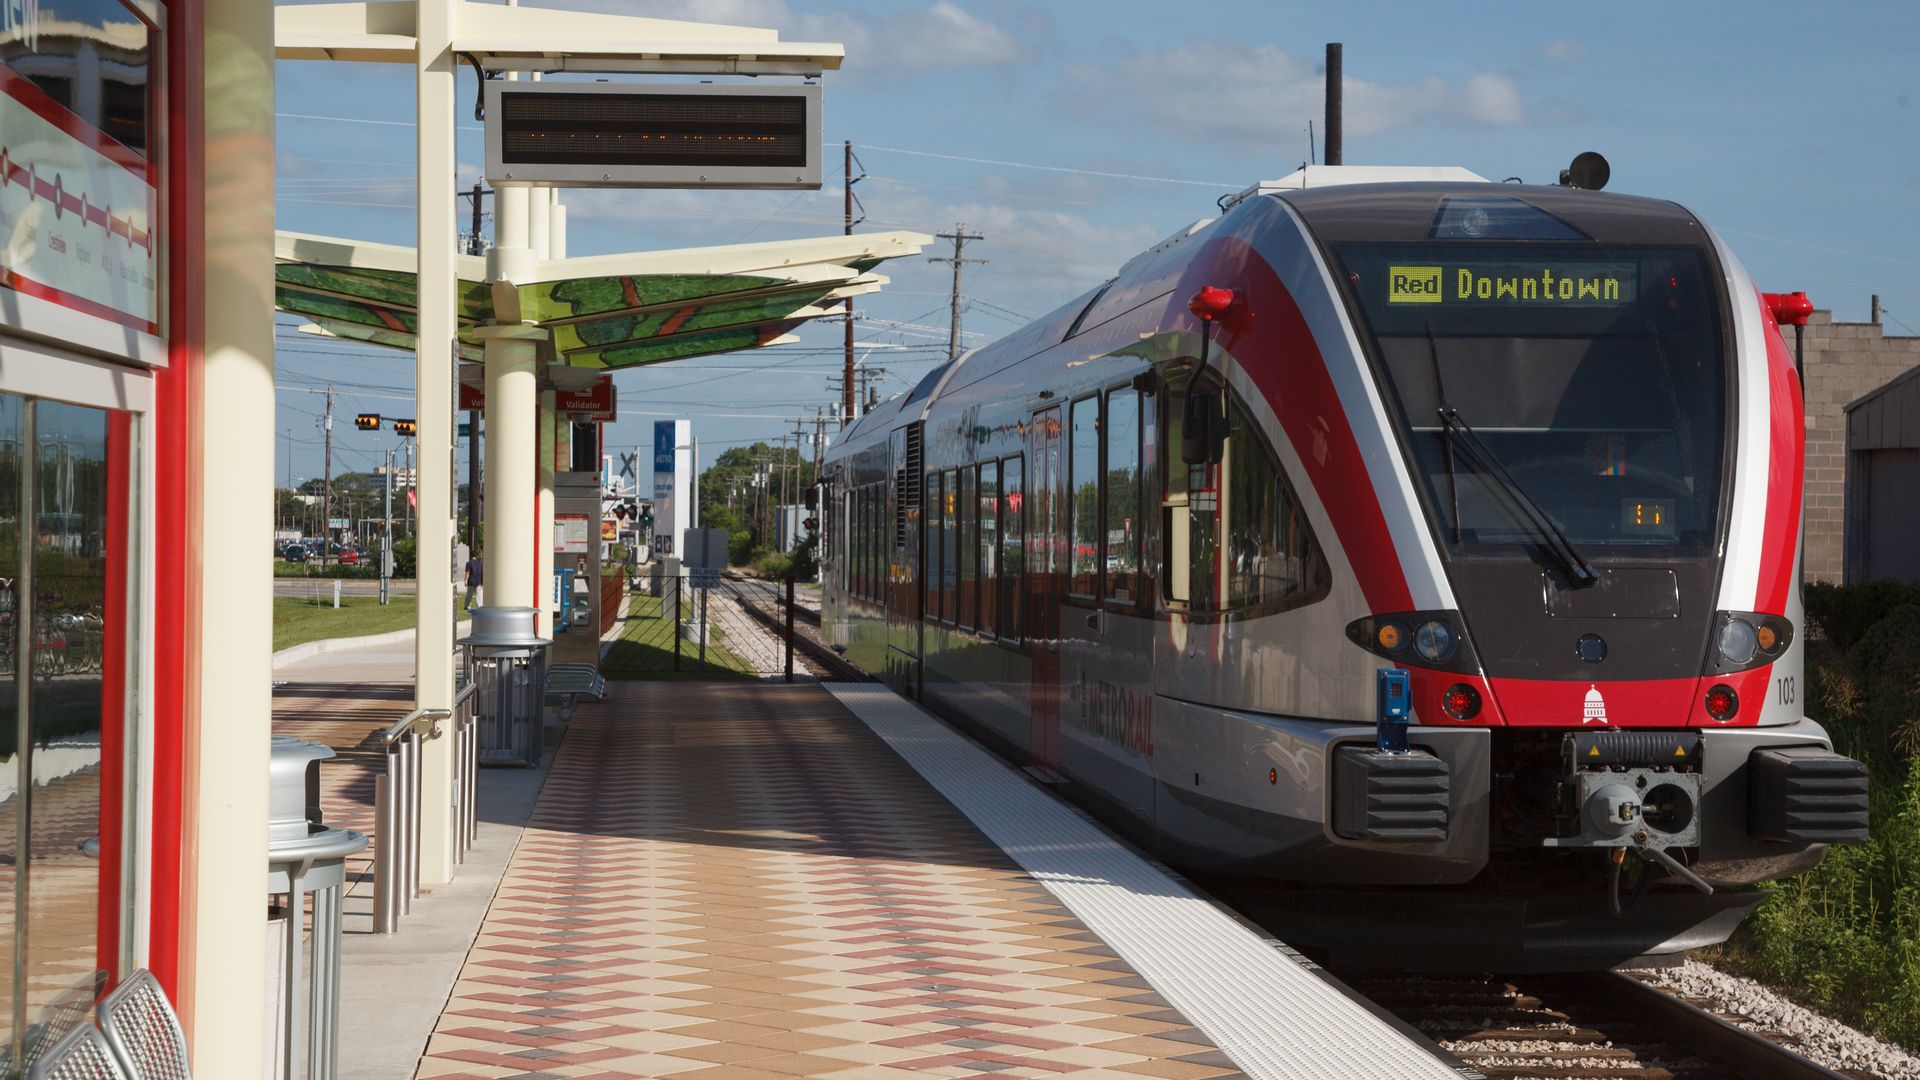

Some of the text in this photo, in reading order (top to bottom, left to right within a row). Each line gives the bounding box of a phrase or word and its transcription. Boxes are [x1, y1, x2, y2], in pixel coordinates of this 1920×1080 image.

[1393, 267, 1619, 300] Red Downtown
[566, 399, 601, 409] Validator
[1777, 675, 1795, 706] 103
[1089, 680, 1154, 758] METRORAIL
